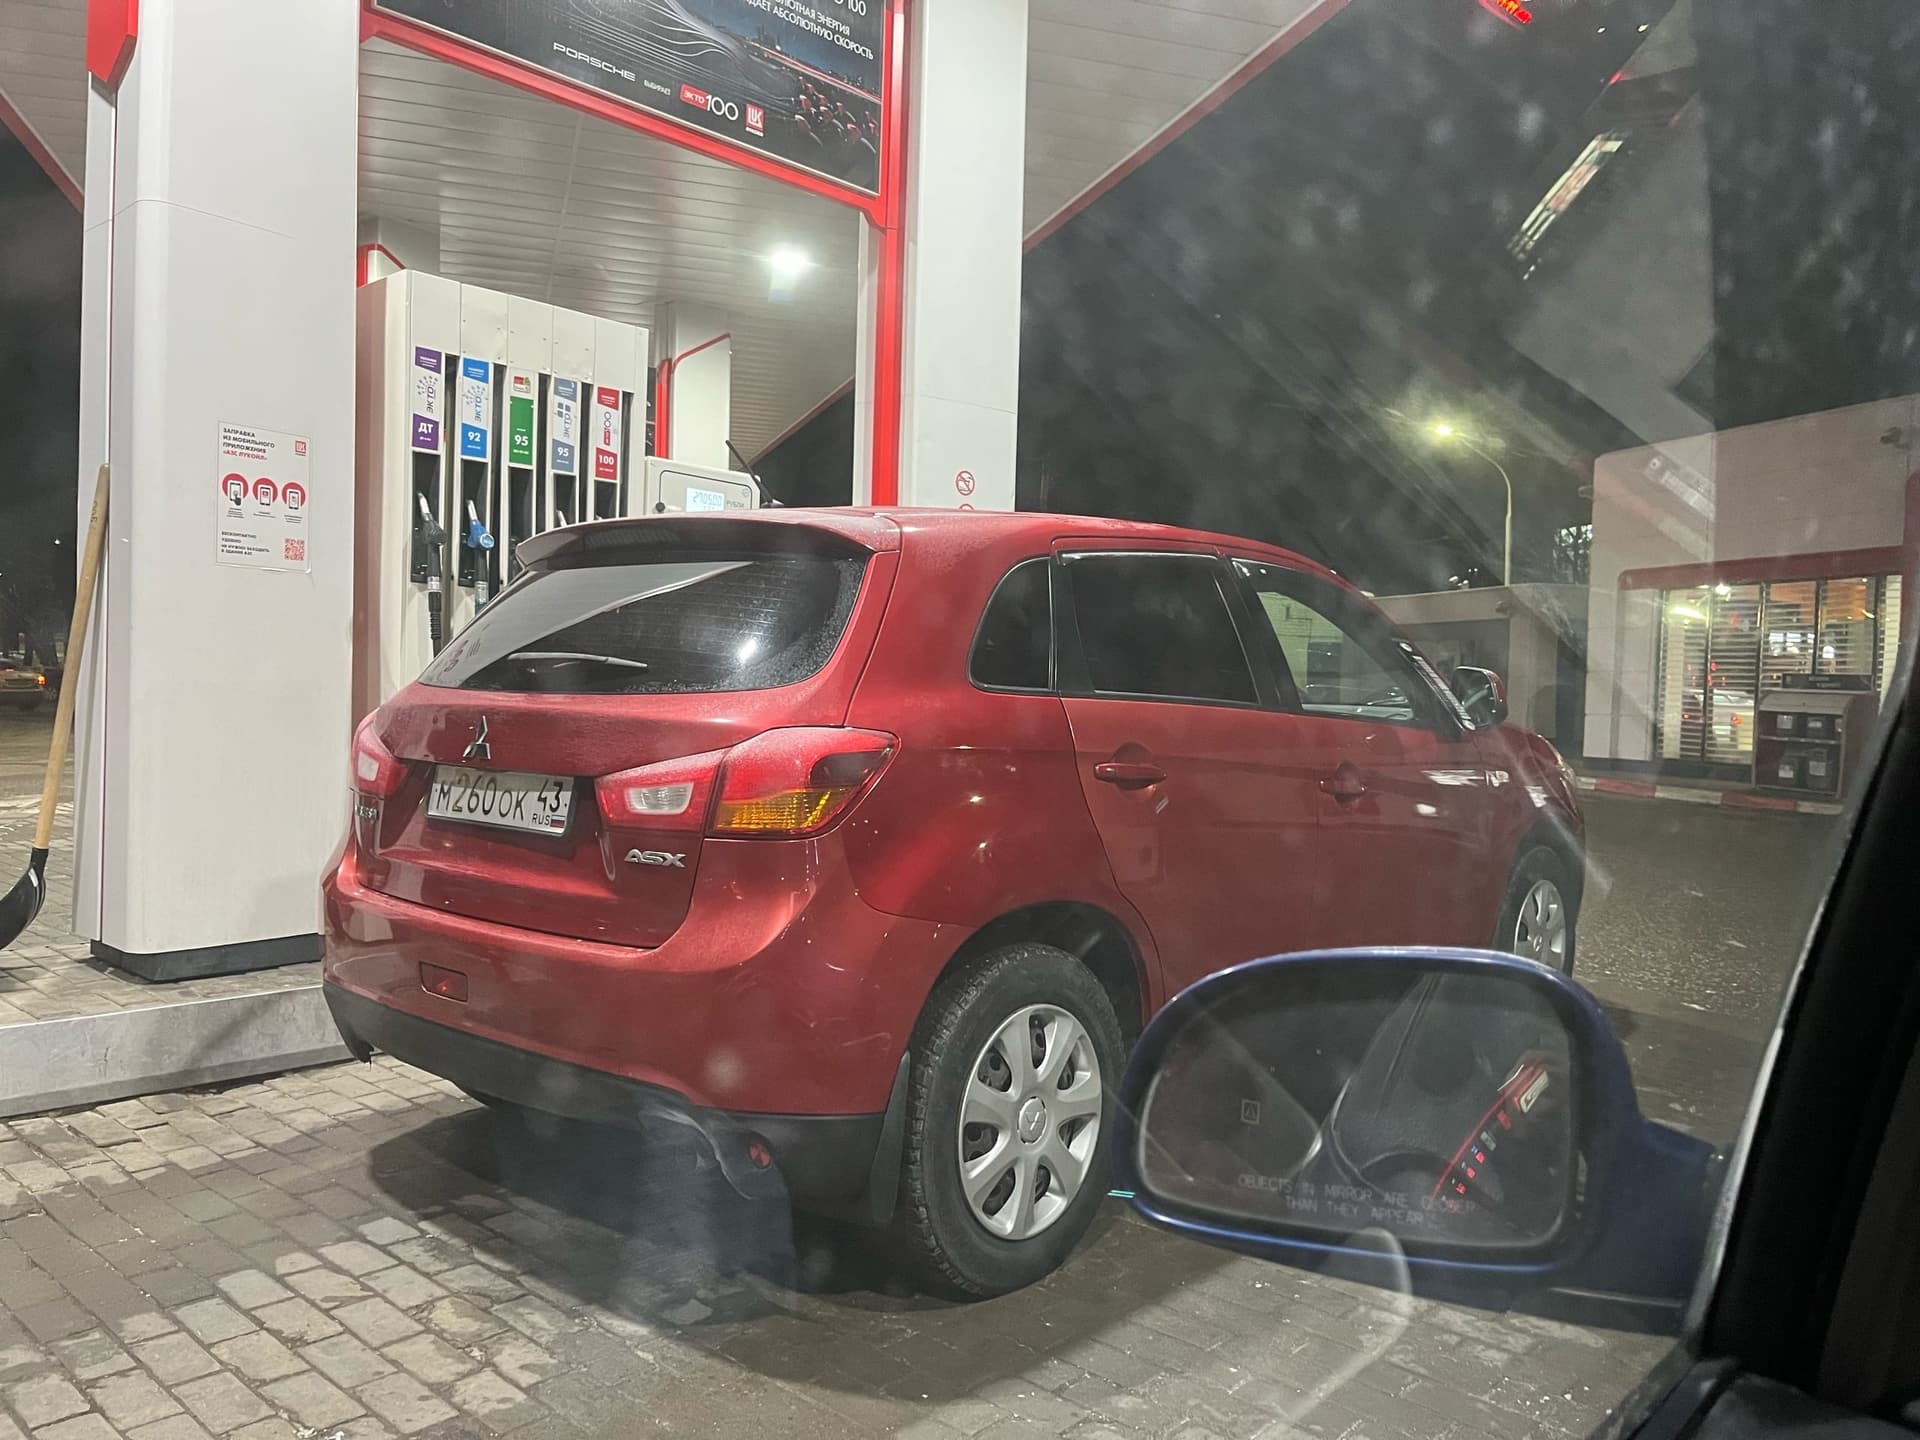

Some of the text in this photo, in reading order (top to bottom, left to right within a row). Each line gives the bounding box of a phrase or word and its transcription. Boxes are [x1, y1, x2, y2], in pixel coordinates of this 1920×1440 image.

[773, 6, 833, 41] АБСОЛЮТНУЮ
[834, 35, 874, 60] СКОРОСТЬ
[817, 11, 850, 36] ЭНЕРГИЯ
[553, 42, 636, 82] PORSCHE
[705, 94, 739, 120] 100
[426, 386, 434, 414] ЭКТО
[474, 396, 482, 422] ЭКТО
[223, 427, 255, 438] ЗАПРАВКА
[418, 422, 434, 434] ДТ
[467, 431, 481, 442] 92
[223, 442, 267, 453] ПРИЛОЖЕНИЯ
[232, 437, 276, 448] МОБИЛЬНОГО
[514, 434, 529, 446] 95
[557, 446, 569, 457] 95
[598, 455, 615, 465] 100
[537, 779, 564, 813] 43
[532, 813, 551, 826] RUS
[623, 848, 687, 868] ASX
[1237, 1174, 1293, 1194] OBJECTS
[1325, 1183, 1373, 1201] MIRROR
[1384, 1191, 1409, 1208] ARE
[1286, 1195, 1318, 1213] THAN
[1327, 1201, 1359, 1217] THEY
